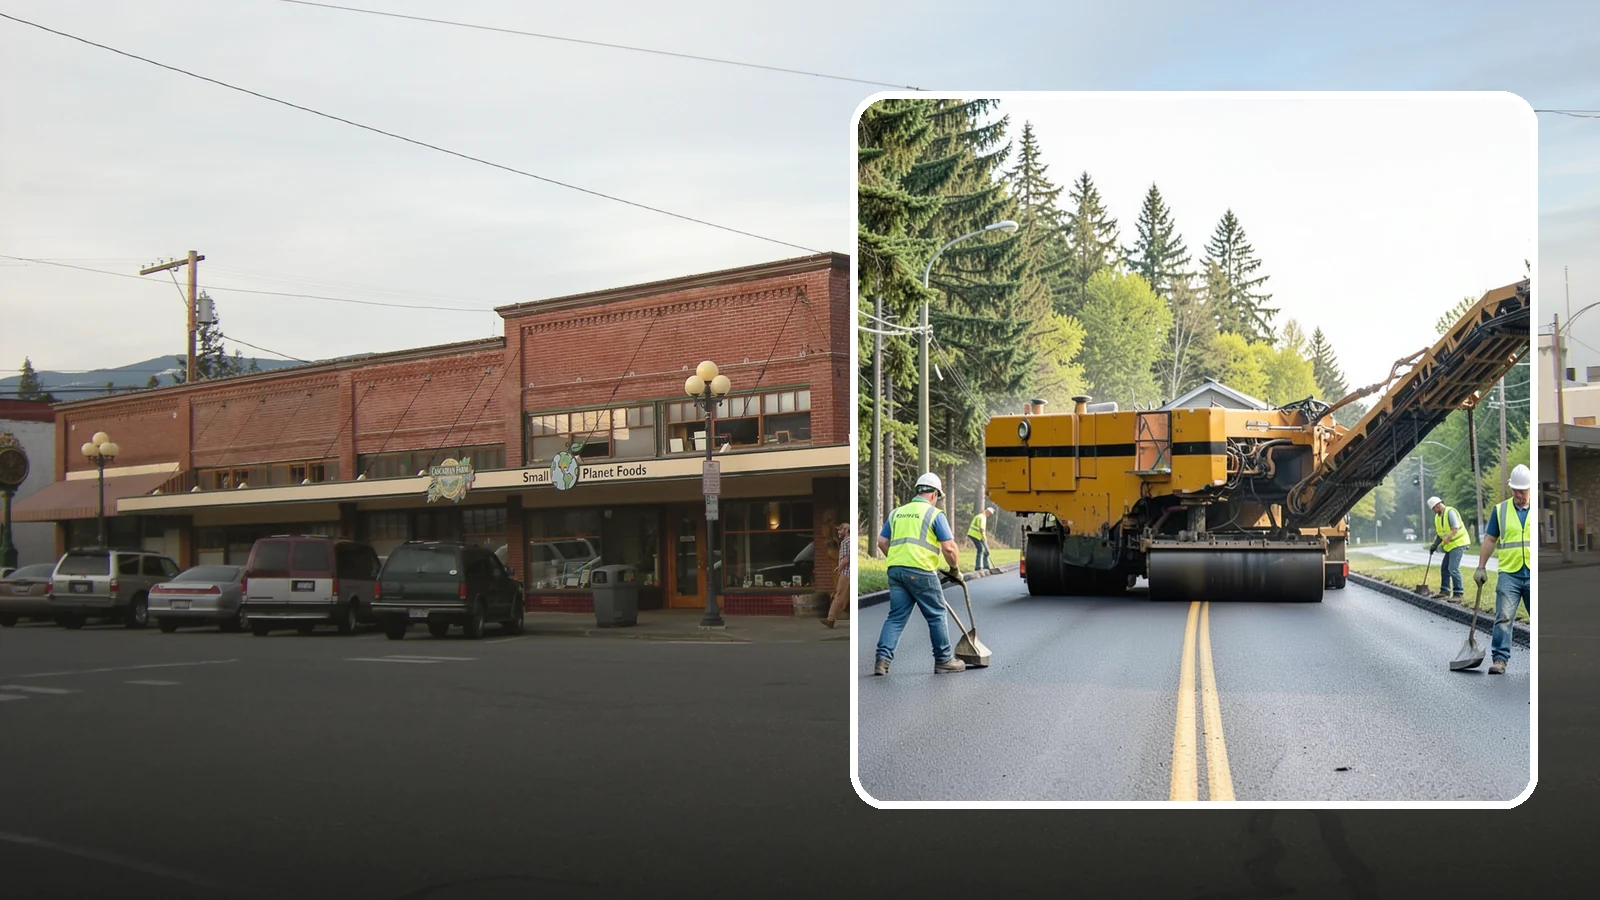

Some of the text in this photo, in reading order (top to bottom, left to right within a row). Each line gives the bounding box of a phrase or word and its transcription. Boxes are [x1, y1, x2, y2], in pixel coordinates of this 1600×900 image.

[523, 464, 647, 483] Small Planet Foods
